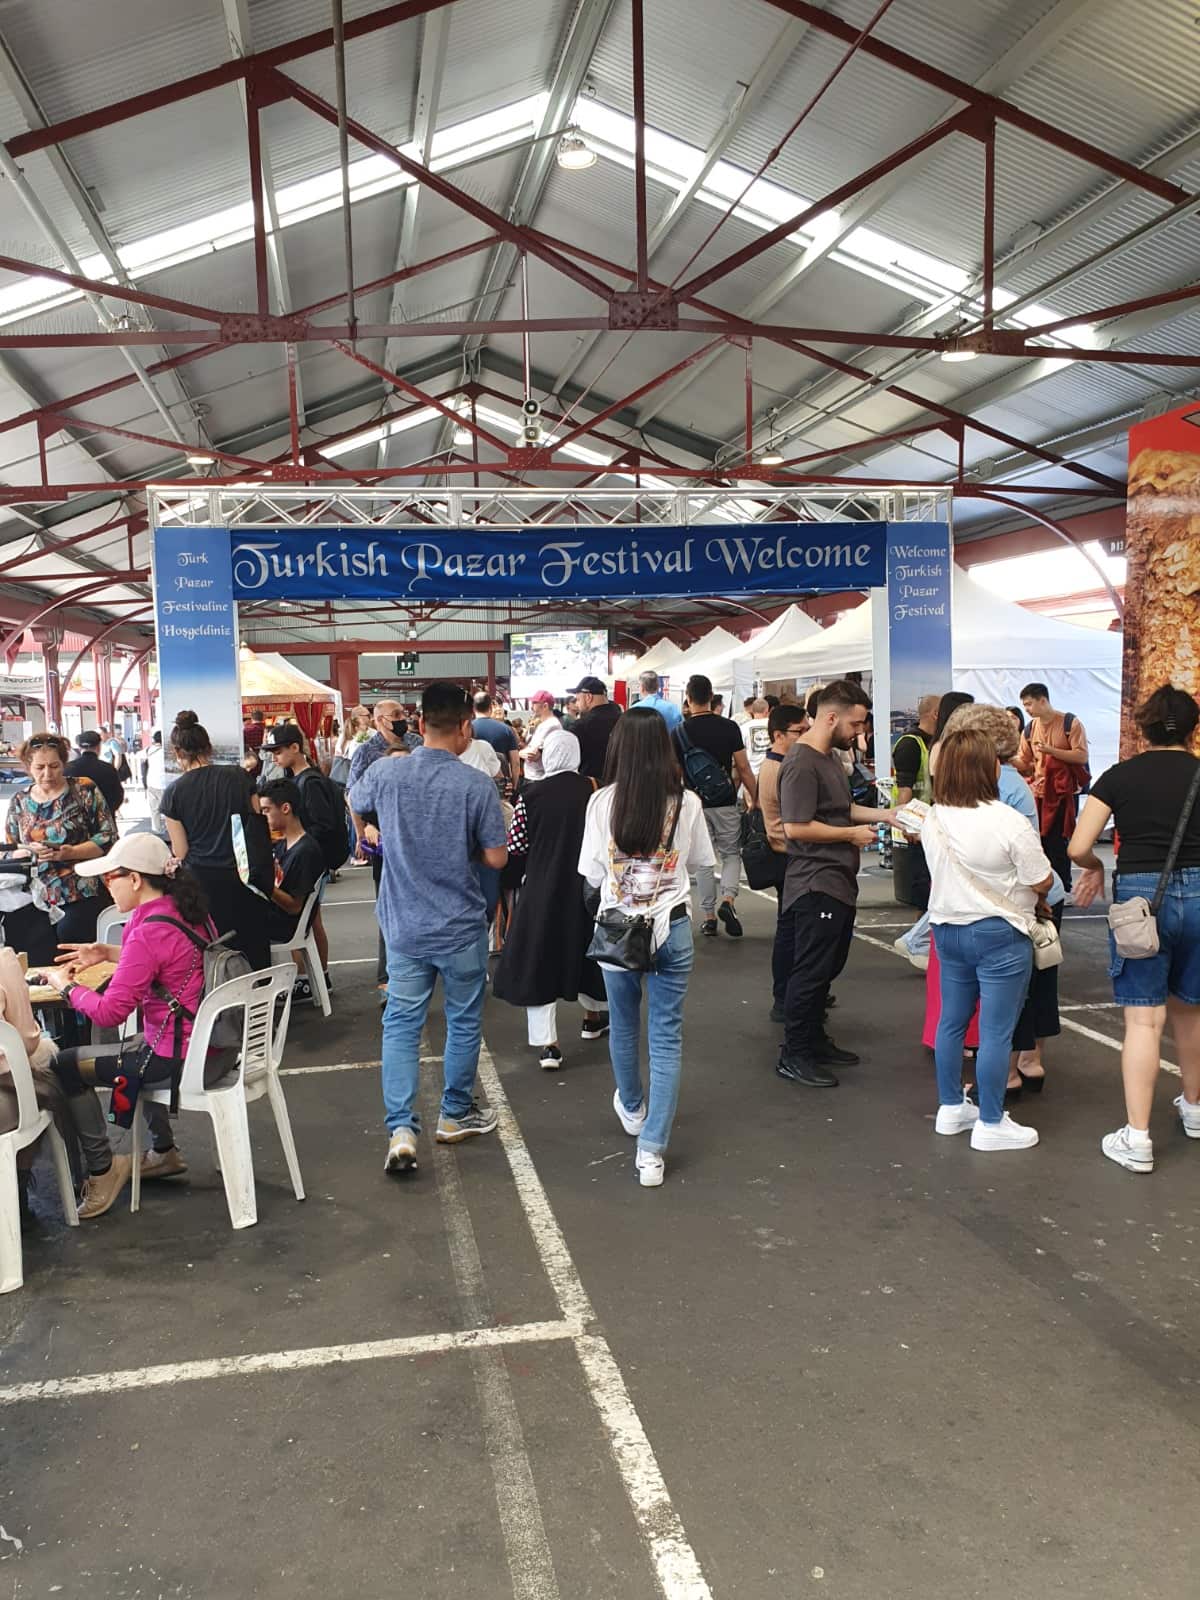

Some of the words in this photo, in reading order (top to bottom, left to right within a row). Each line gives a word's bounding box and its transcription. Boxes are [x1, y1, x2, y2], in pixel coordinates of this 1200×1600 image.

[890, 545, 947, 559] Welcome
[232, 541, 388, 589] Turkish
[401, 542, 525, 592] Pazar
[538, 538, 695, 587] Festival
[705, 535, 871, 576] Welcome
[895, 564, 942, 581] Turkish
[174, 576, 214, 593] Pazar
[899, 584, 940, 601] Pazar
[162, 600, 228, 615] Festivaline
[894, 603, 945, 620] Festival
